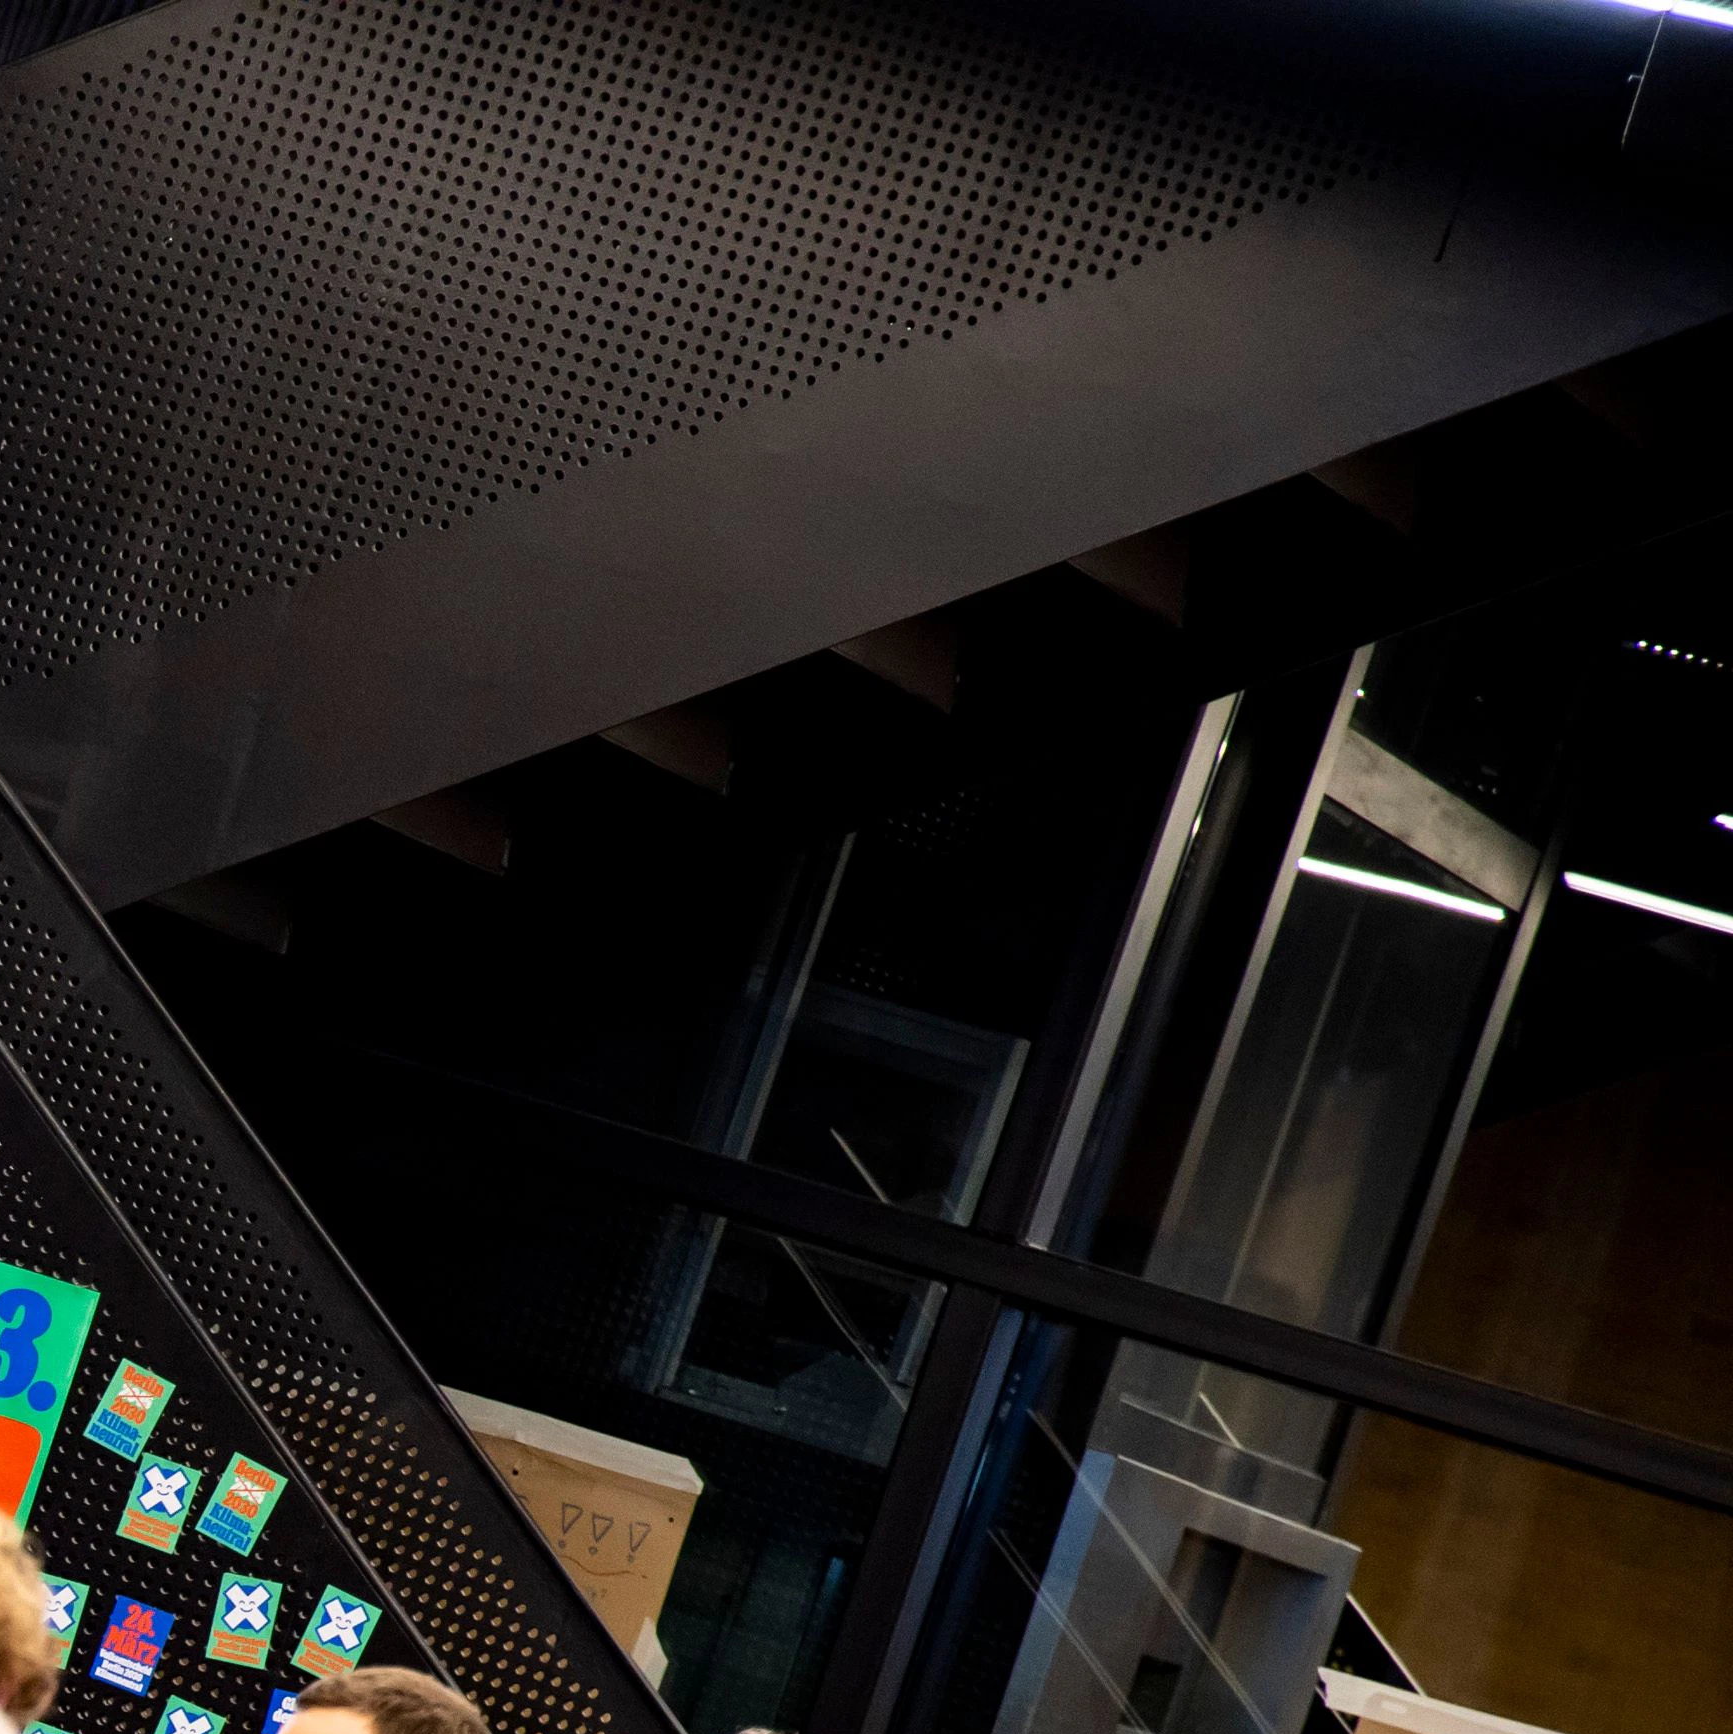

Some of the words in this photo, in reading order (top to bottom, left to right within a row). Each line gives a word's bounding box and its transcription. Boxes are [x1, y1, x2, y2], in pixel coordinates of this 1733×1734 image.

[122, 1365, 166, 1398] Berlin
[109, 1396, 148, 1425] 2030
[234, 1459, 278, 1492] Berlin
[221, 1490, 260, 1519] 2030
[121, 1603, 154, 1638] 26.
[101, 1627, 159, 1665] März
